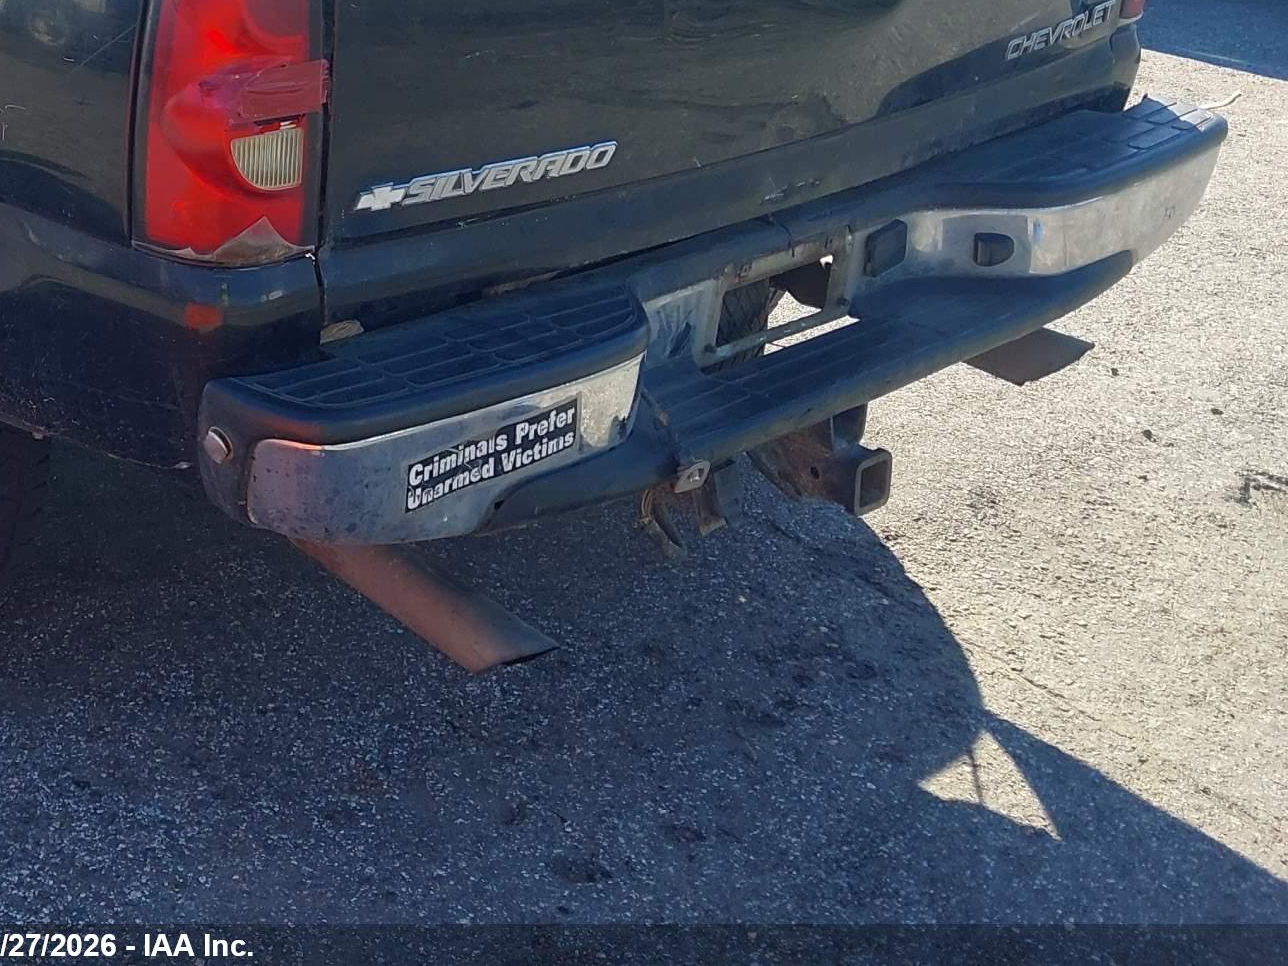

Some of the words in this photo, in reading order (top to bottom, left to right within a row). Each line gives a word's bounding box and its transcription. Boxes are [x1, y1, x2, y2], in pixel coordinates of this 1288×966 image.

[1006, 0, 1116, 61] CHEVROLET
[402, 140, 618, 206] SILVERADO
[407, 457, 495, 510] Unarmed
[501, 431, 575, 473] Victims
[409, 433, 508, 486] Criminals
[515, 407, 575, 445] Prefer
